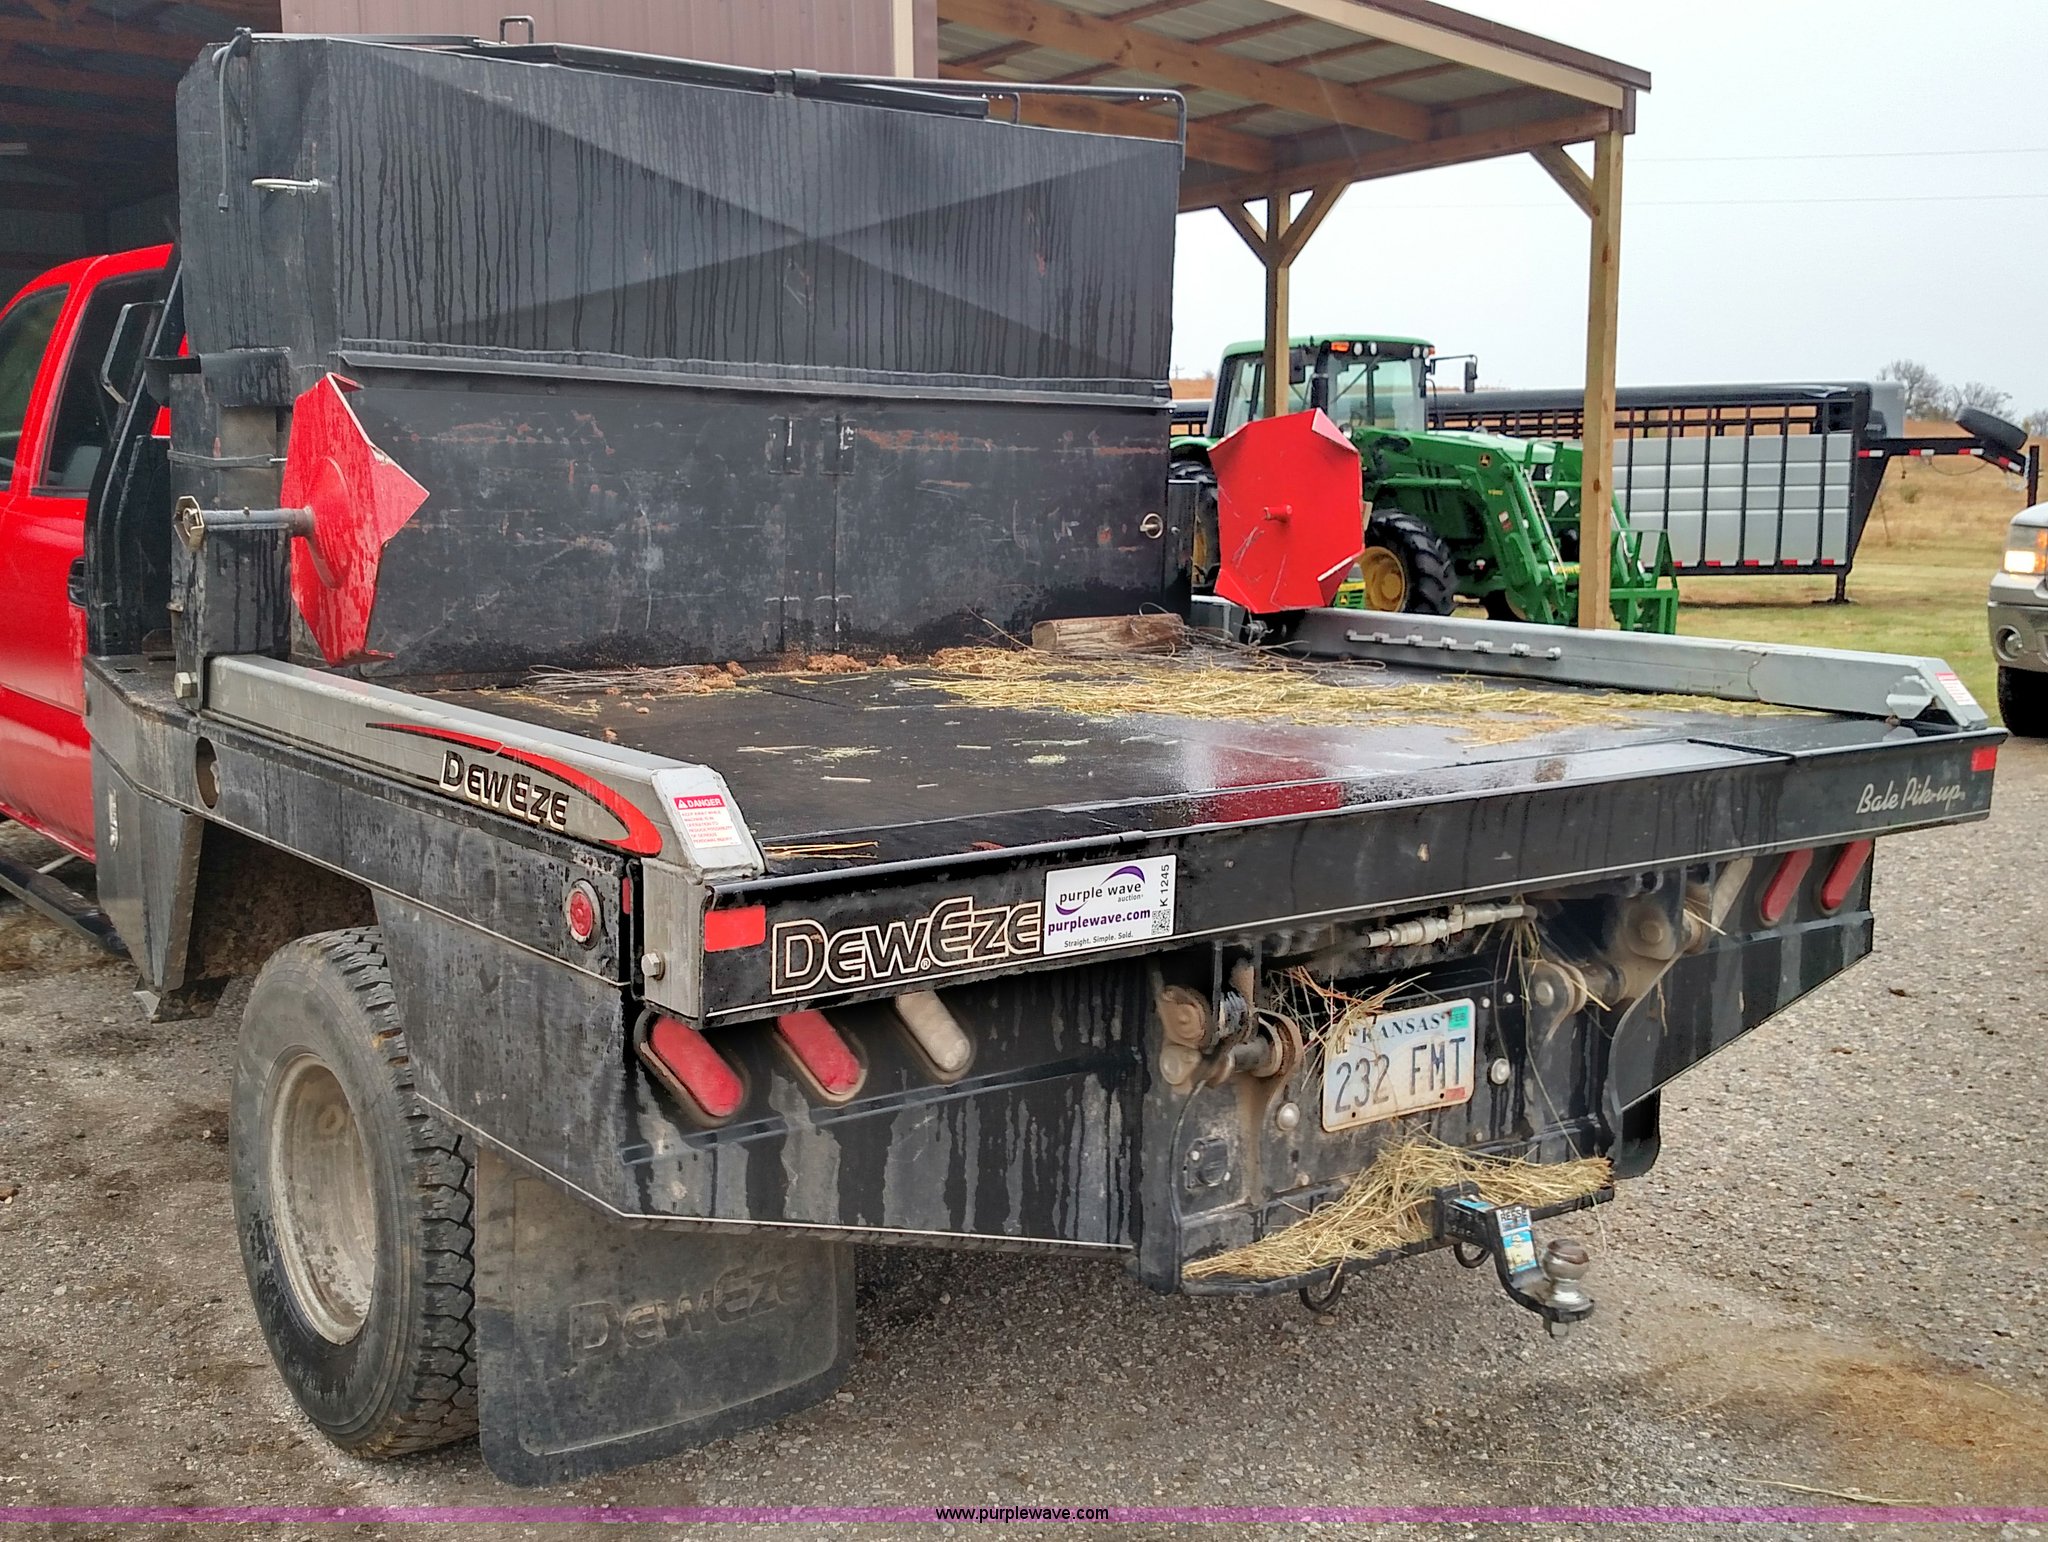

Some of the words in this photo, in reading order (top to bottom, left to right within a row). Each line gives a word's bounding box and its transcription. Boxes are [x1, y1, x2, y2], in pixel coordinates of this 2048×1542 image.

[687, 798, 722, 808] DANGER
[1856, 780, 1899, 814] Bale
[1160, 864, 1170, 894] 1245
[1059, 886, 1103, 906] purple
[1107, 882, 1142, 896] wave
[1159, 897, 1169, 907] K
[1048, 908, 1151, 936] purplewave.com
[1064, 938, 1092, 948] Straight.
[1092, 935, 1117, 945] Simple.
[1118, 931, 1134, 940] Sold.
[1334, 1053, 1391, 1114] 232
[1409, 1036, 1466, 1096] FMT
